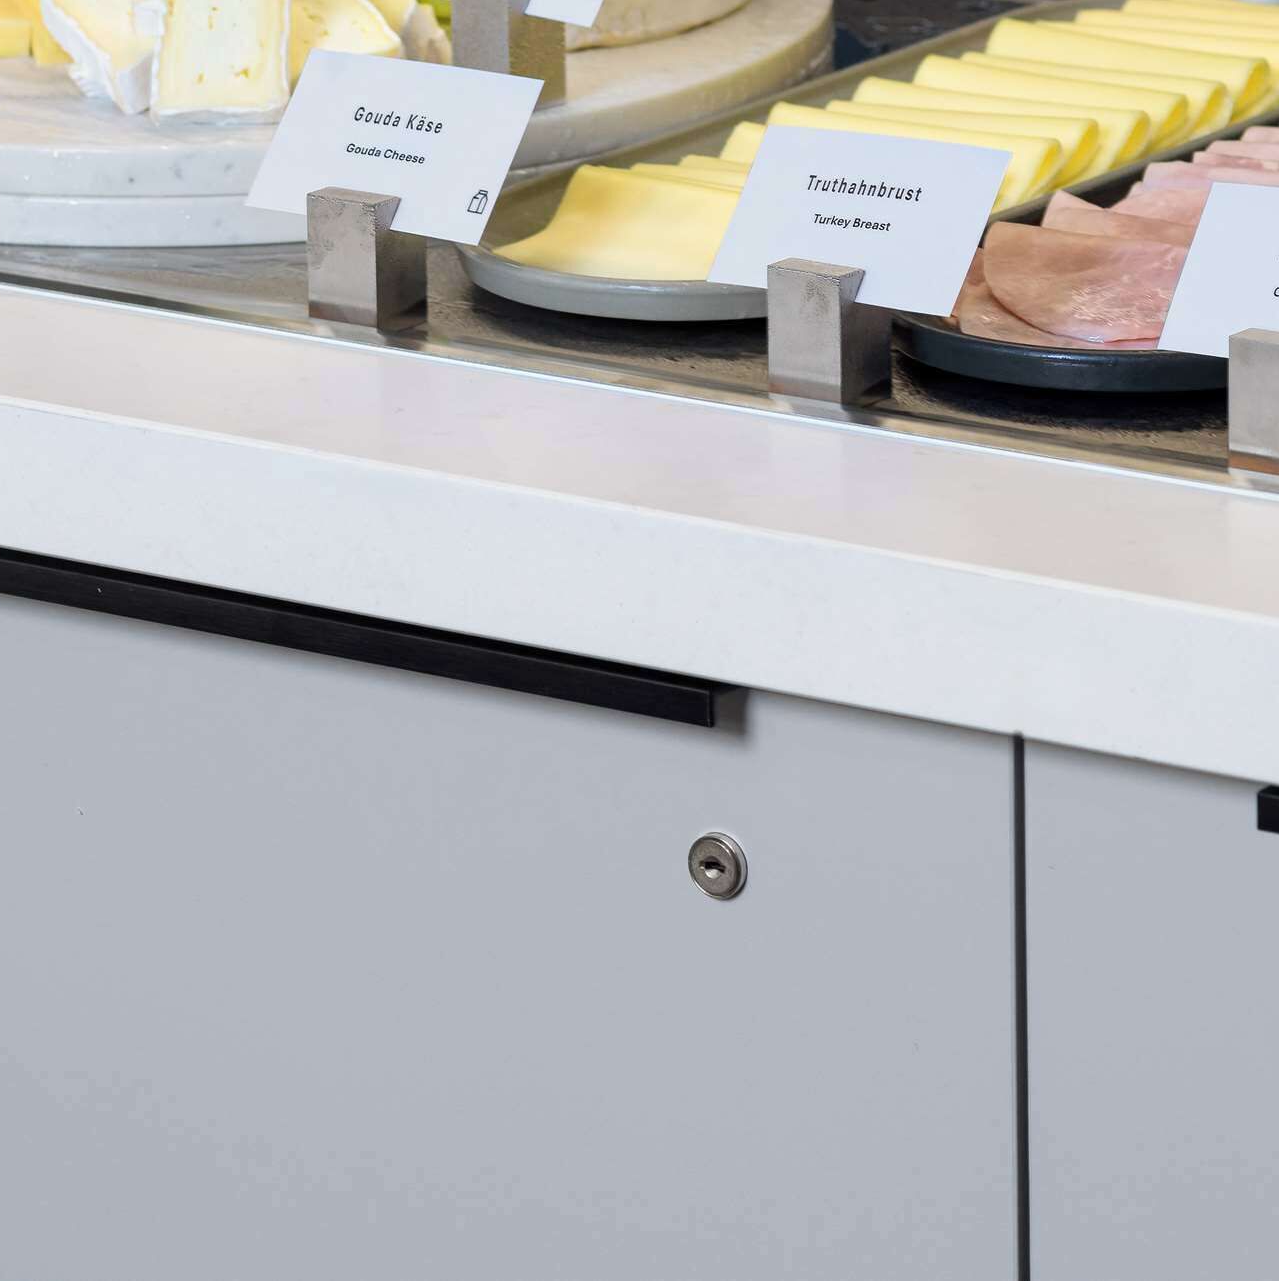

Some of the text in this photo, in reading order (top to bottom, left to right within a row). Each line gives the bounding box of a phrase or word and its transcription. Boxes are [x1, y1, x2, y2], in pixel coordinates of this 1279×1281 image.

[353, 106, 443, 134] Gouda Käse
[346, 142, 425, 165] Gouda Cheese
[807, 174, 923, 202] Truthahnbrust
[813, 213, 891, 232] Turkey Breast
